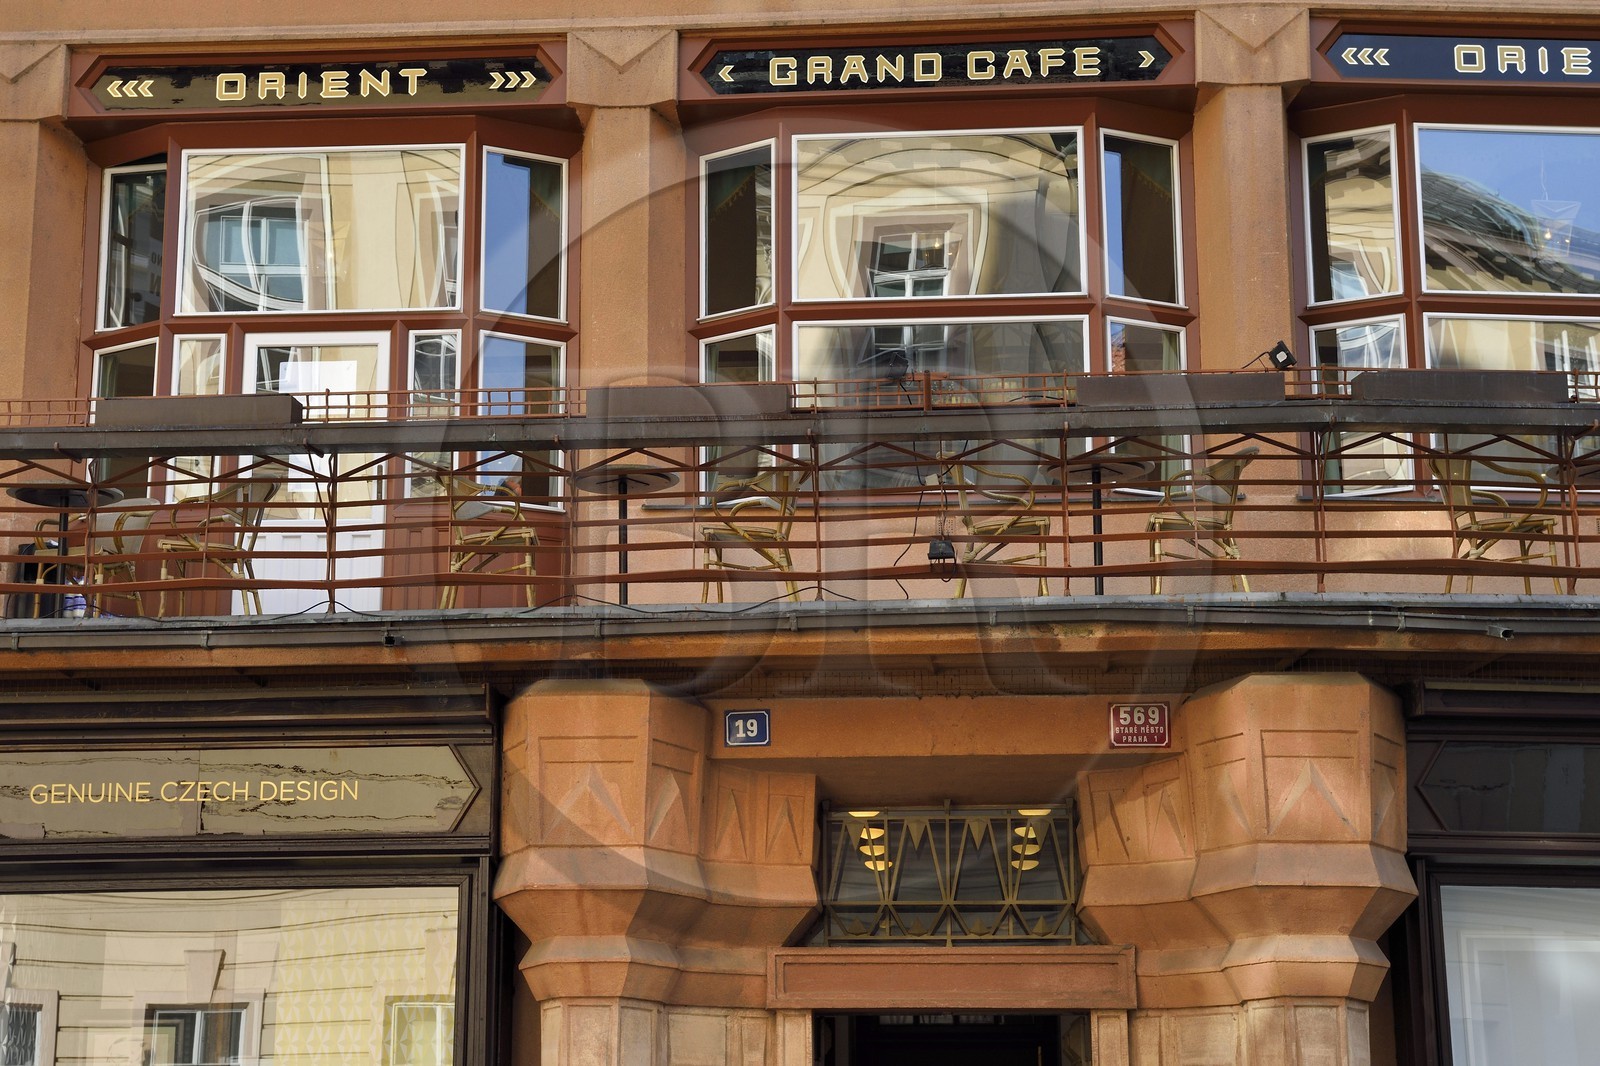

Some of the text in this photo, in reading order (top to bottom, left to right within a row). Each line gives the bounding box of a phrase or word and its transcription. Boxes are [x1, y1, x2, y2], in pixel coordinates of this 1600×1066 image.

[769, 46, 1101, 86] GRAND CAFE
[1454, 44, 1593, 76] ORIE
[216, 68, 428, 101] ORIENT
[1119, 706, 1160, 725] 569
[735, 718, 758, 738] 19
[1115, 725, 1164, 734] STARÉ MĚSTO
[1122, 735, 1158, 743] PRAHA 1
[30, 780, 359, 805] GENUINE CZECH DESIGN
